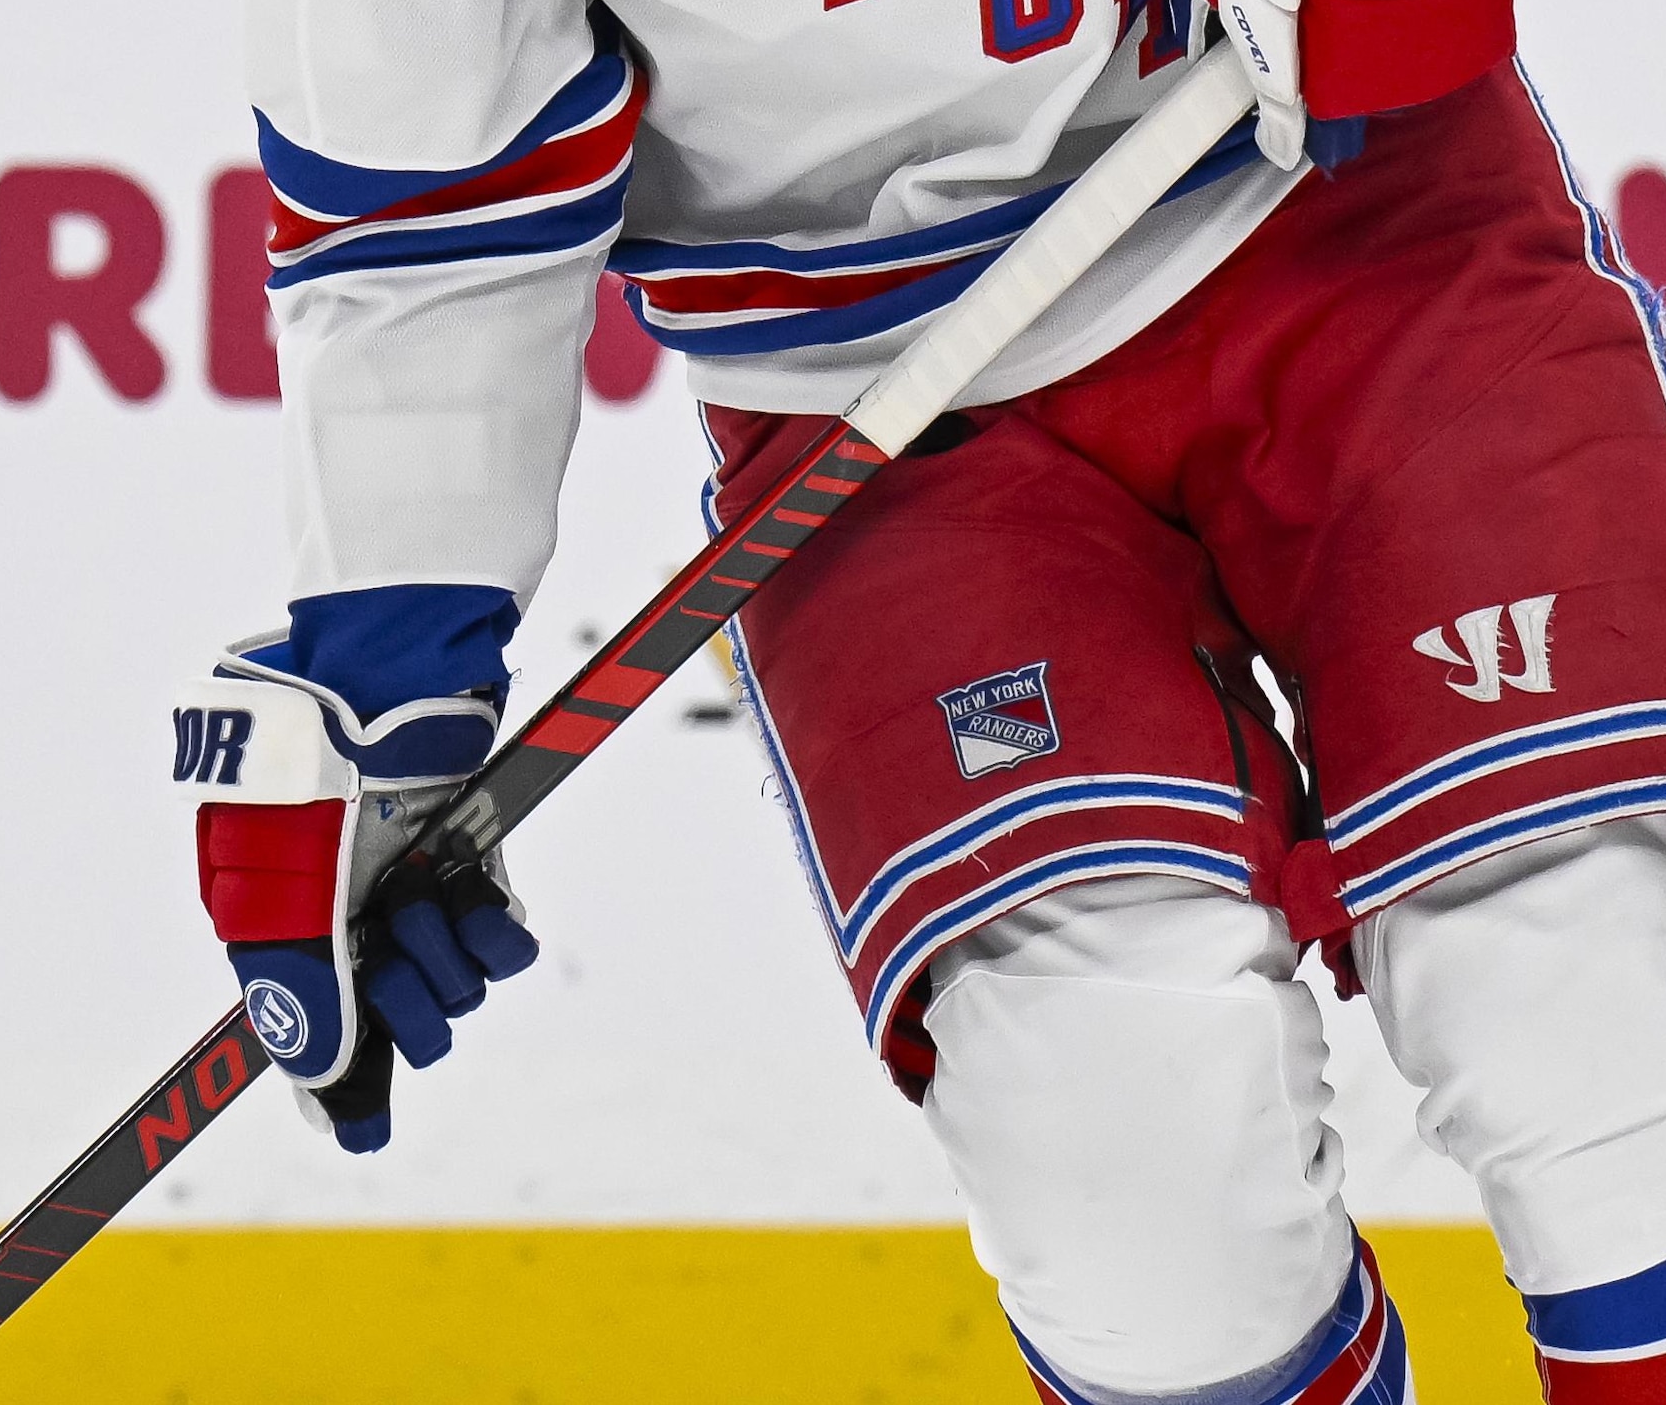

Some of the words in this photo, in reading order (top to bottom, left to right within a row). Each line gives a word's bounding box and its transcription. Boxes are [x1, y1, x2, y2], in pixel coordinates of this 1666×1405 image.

[1231, 3, 1271, 75] COVER
[950, 690, 986, 718] NEW
[990, 676, 1038, 702] YORK
[172, 706, 256, 787] OR
[967, 715, 1048, 748] RANGERS
